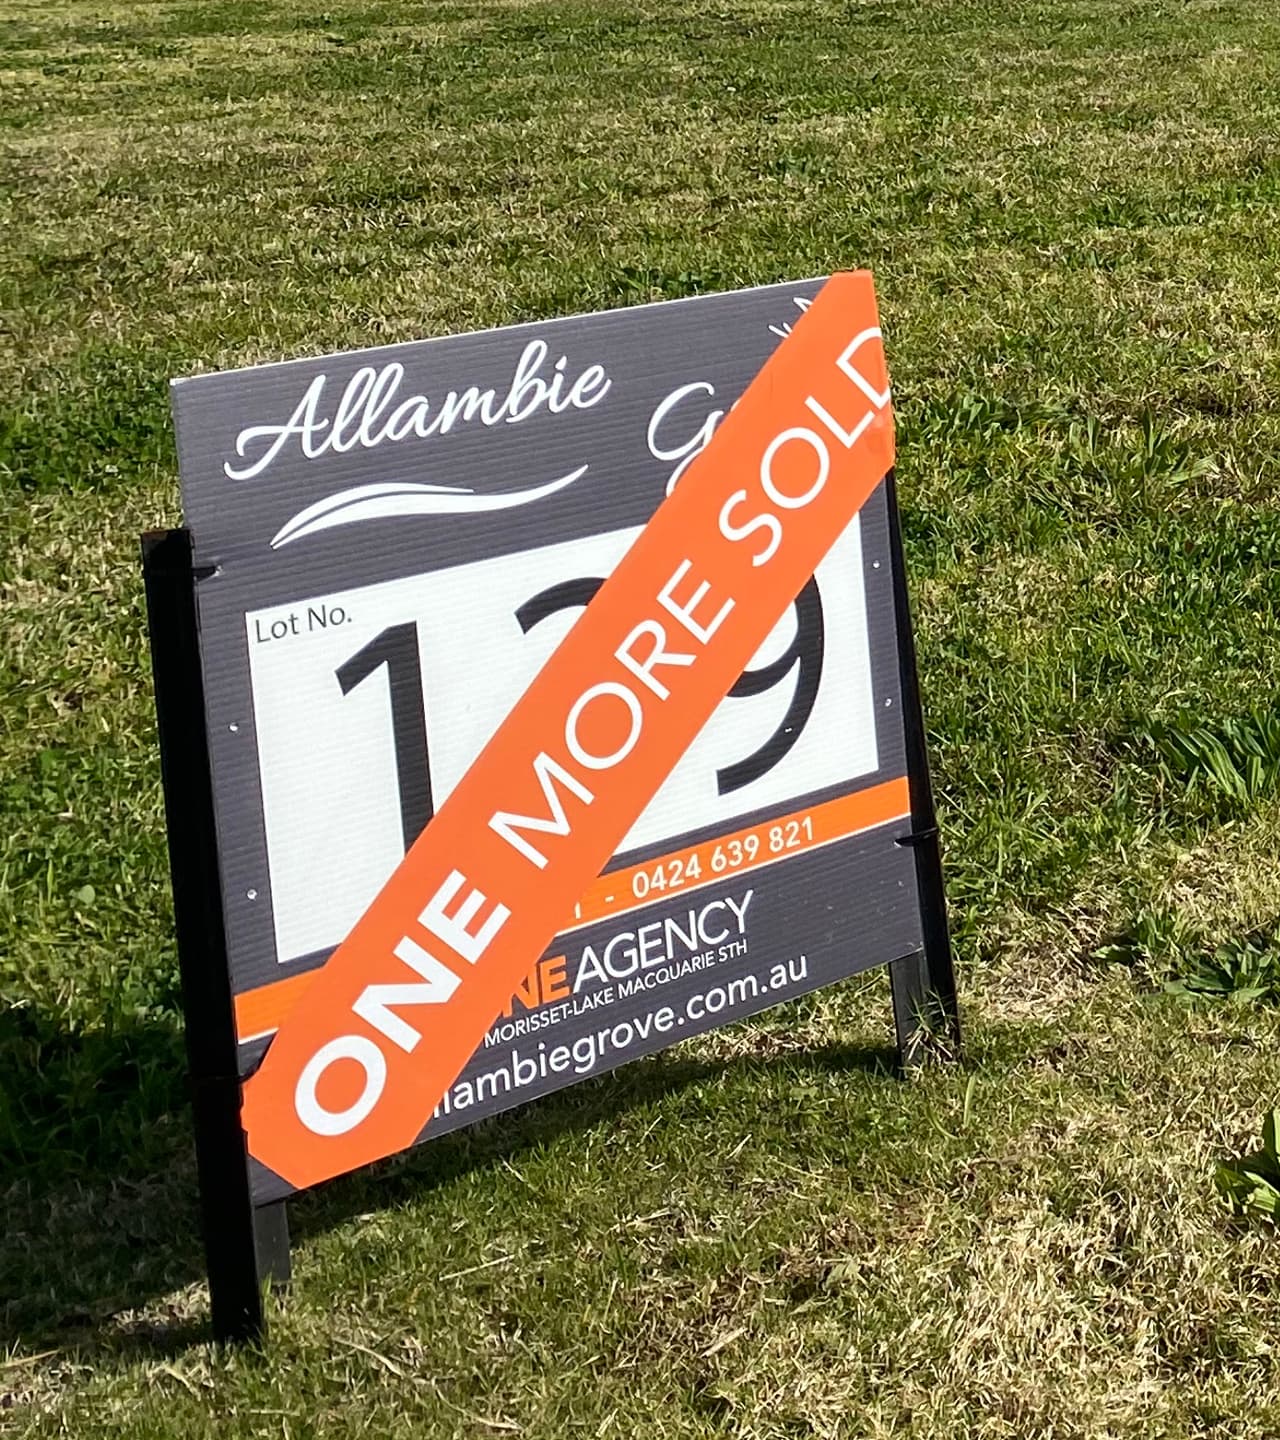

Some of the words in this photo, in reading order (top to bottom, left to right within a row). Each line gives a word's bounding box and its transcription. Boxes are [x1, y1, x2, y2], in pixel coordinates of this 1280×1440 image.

[223, 340, 614, 481] Allambie
[255, 613, 300, 644] Lot
[307, 603, 353, 632] No.
[294, 869, 512, 1137] ONE
[487, 559, 735, 870] MORE
[718, 326, 891, 567] SOLD
[335, 571, 826, 862] 19
[632, 854, 702, 899] 0424
[711, 834, 760, 873] 639
[769, 816, 814, 853] 821
[484, 986, 615, 1049] MORISSET-LAKE
[618, 951, 716, 999] MACQUARIE
[718, 939, 748, 962] STH
